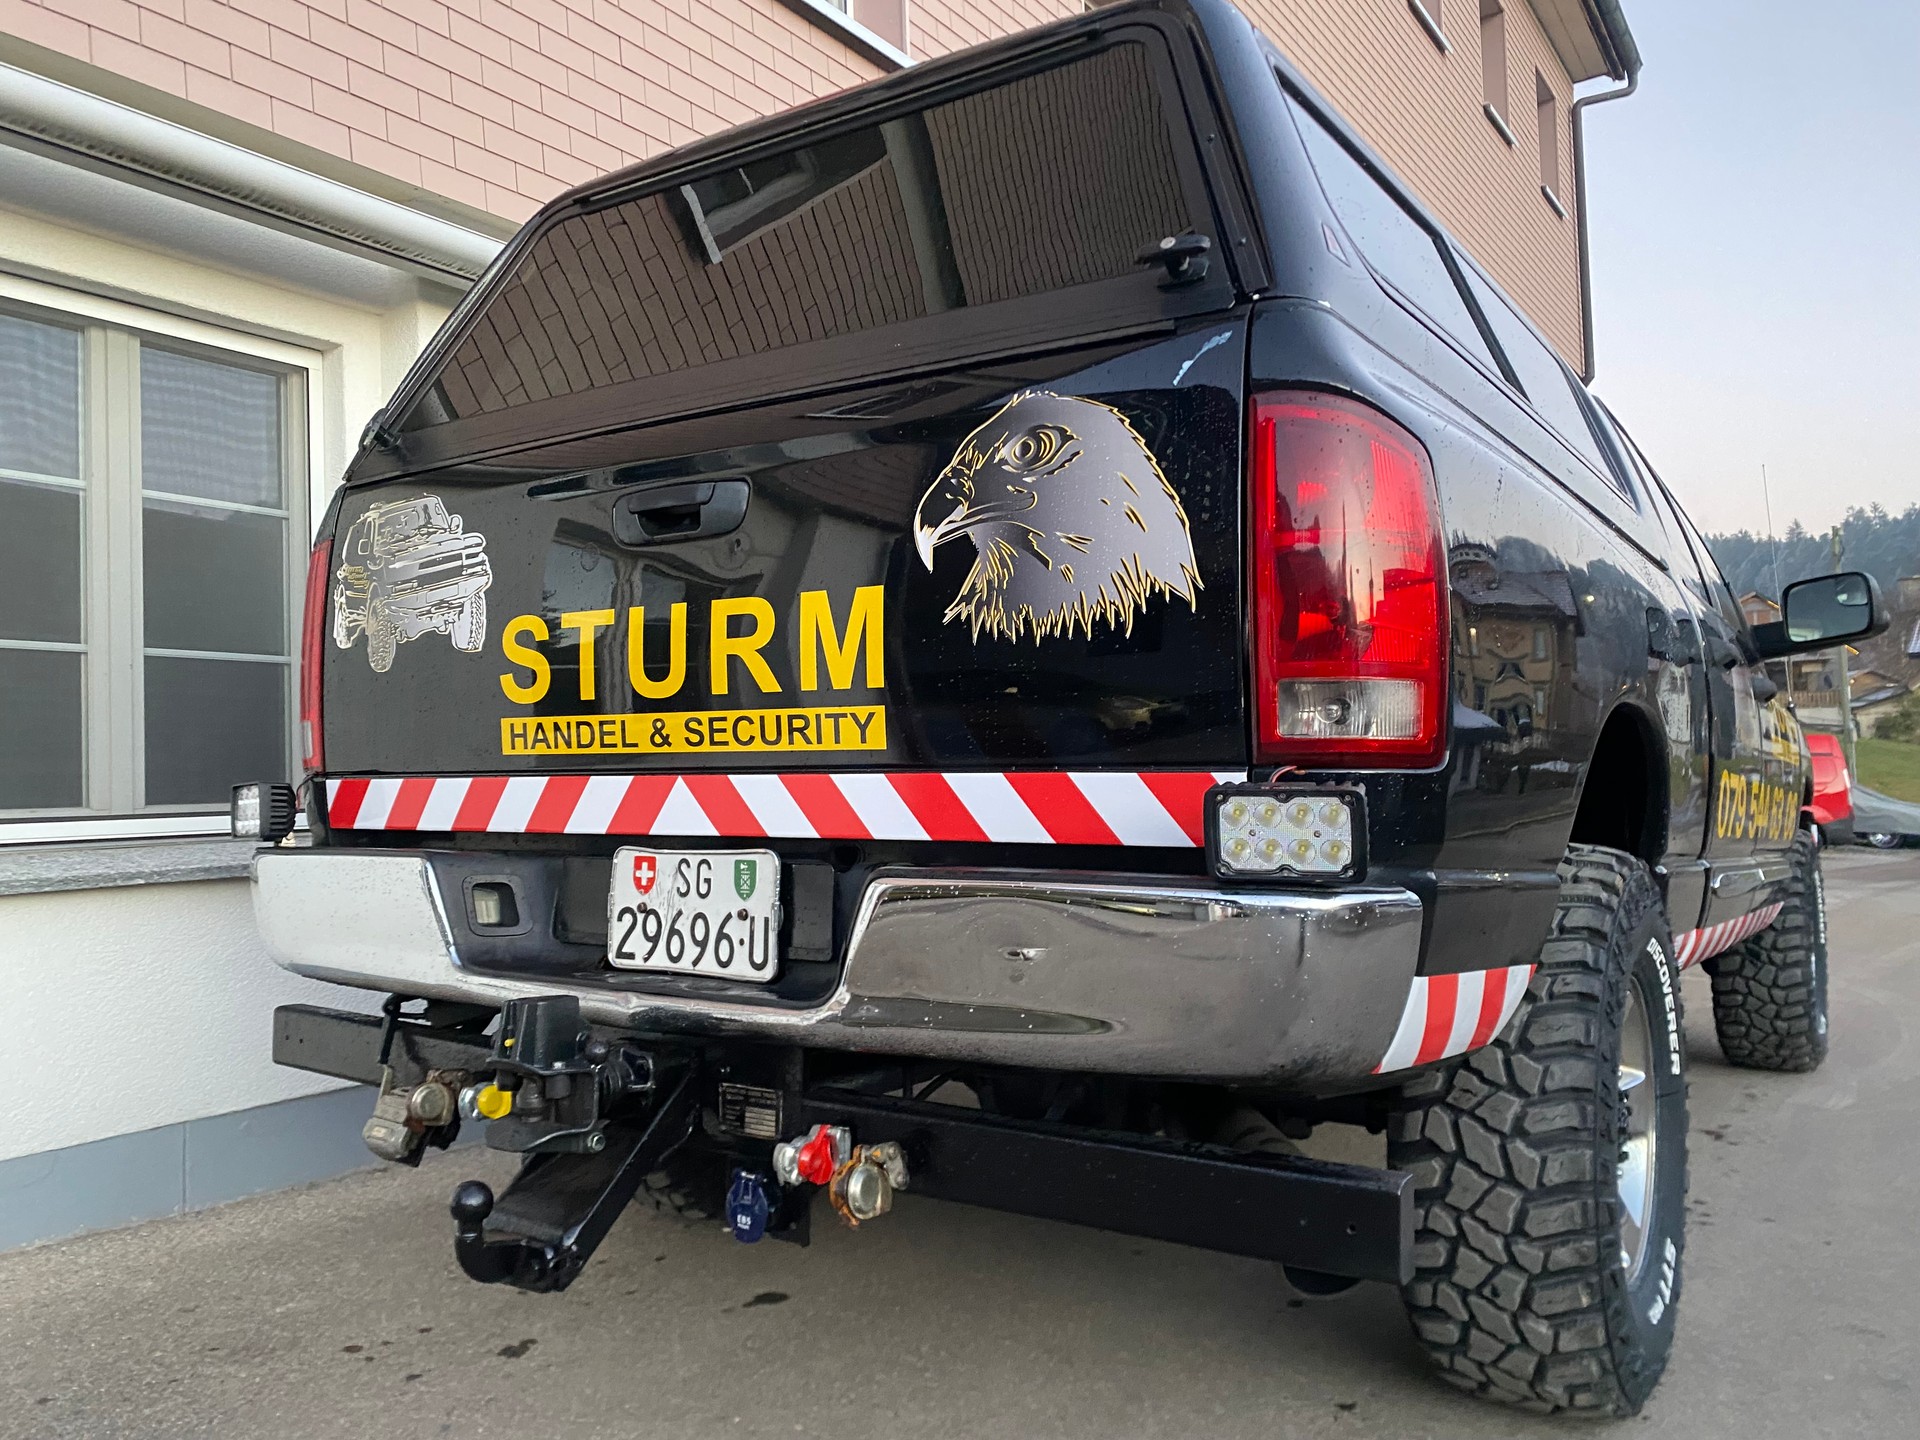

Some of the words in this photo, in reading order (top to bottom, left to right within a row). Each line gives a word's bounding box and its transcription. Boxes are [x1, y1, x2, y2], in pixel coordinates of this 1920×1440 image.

[499, 585, 884, 704] STURM
[509, 719, 639, 750] HANDEL
[649, 717, 673, 748] &
[684, 711, 876, 747] SECURITY
[1717, 768, 1747, 839] 079
[676, 857, 712, 899] SG
[1646, 937, 1681, 1076] DISCOVERER
